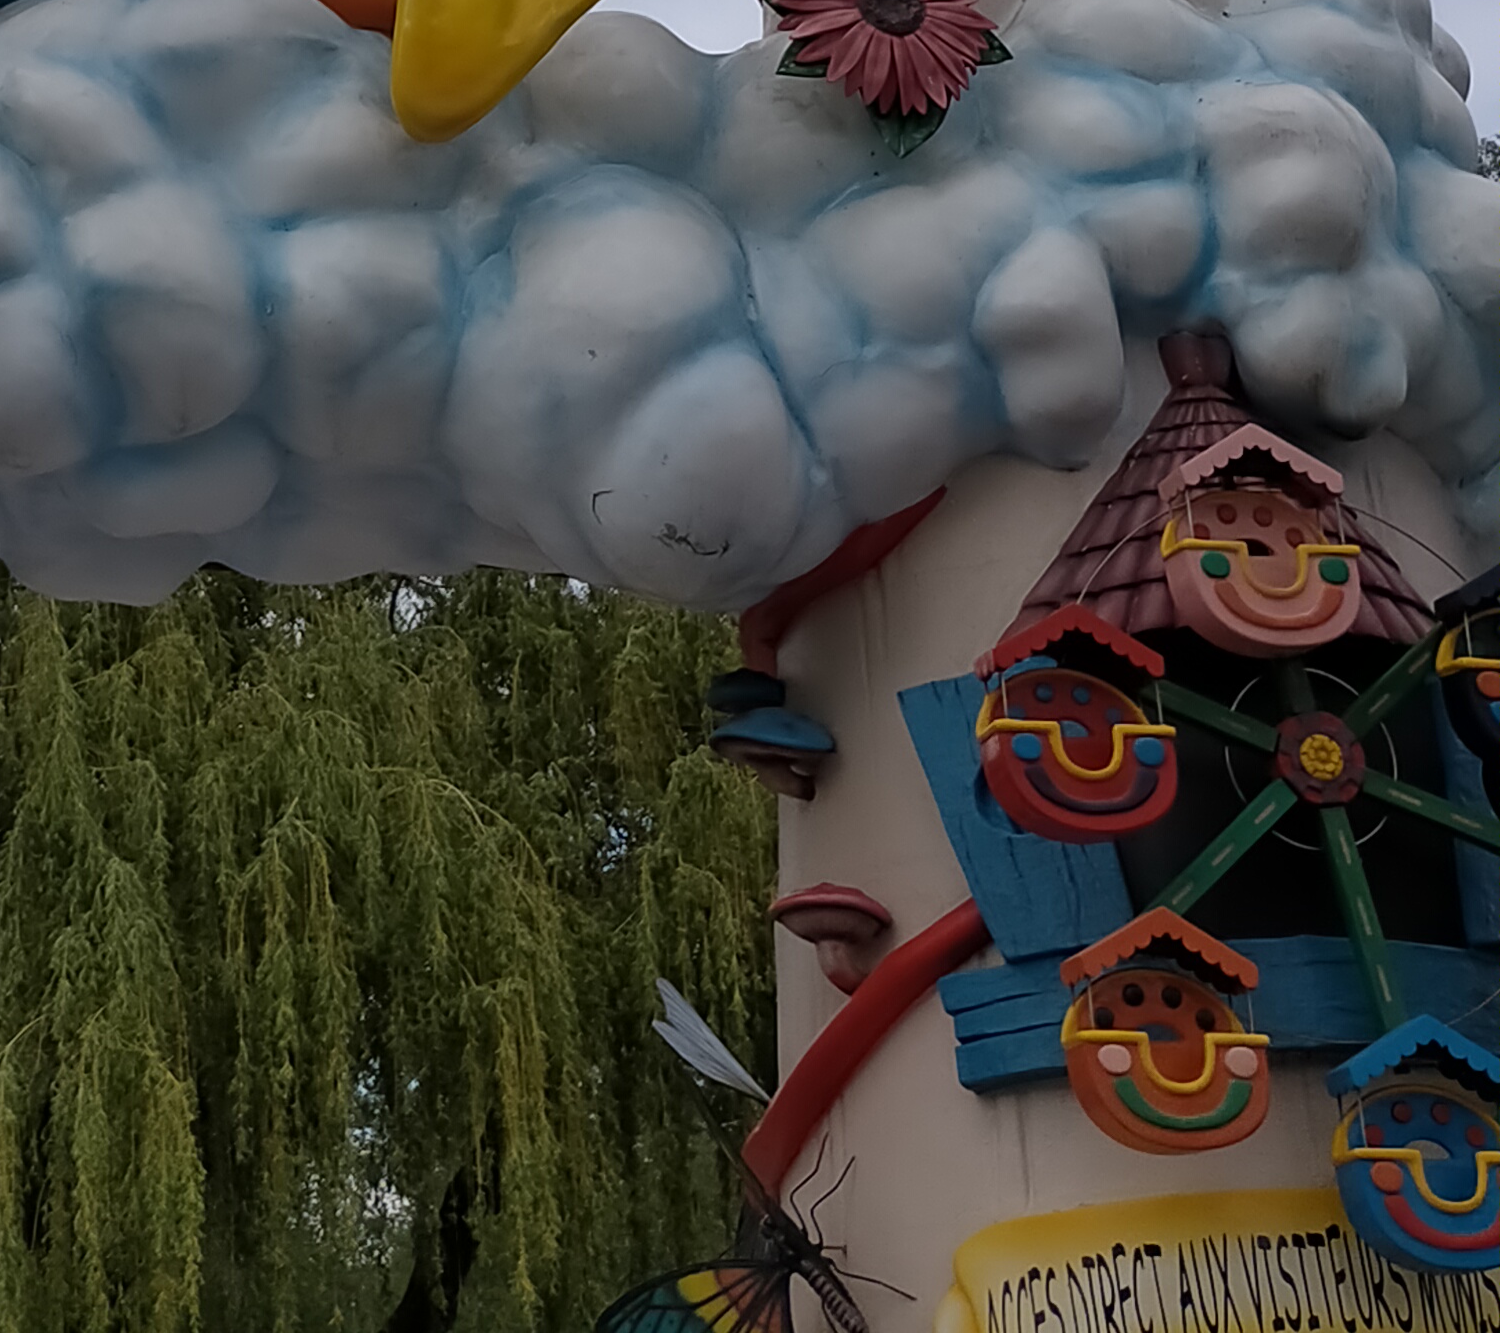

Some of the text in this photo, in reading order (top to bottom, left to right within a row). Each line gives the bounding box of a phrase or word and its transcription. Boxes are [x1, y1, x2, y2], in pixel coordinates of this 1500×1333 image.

[1065, 1242, 1169, 1333] DIRECT
[1178, 1233, 1244, 1333] AUX
[1237, 1223, 1413, 1333] VISITEURS
